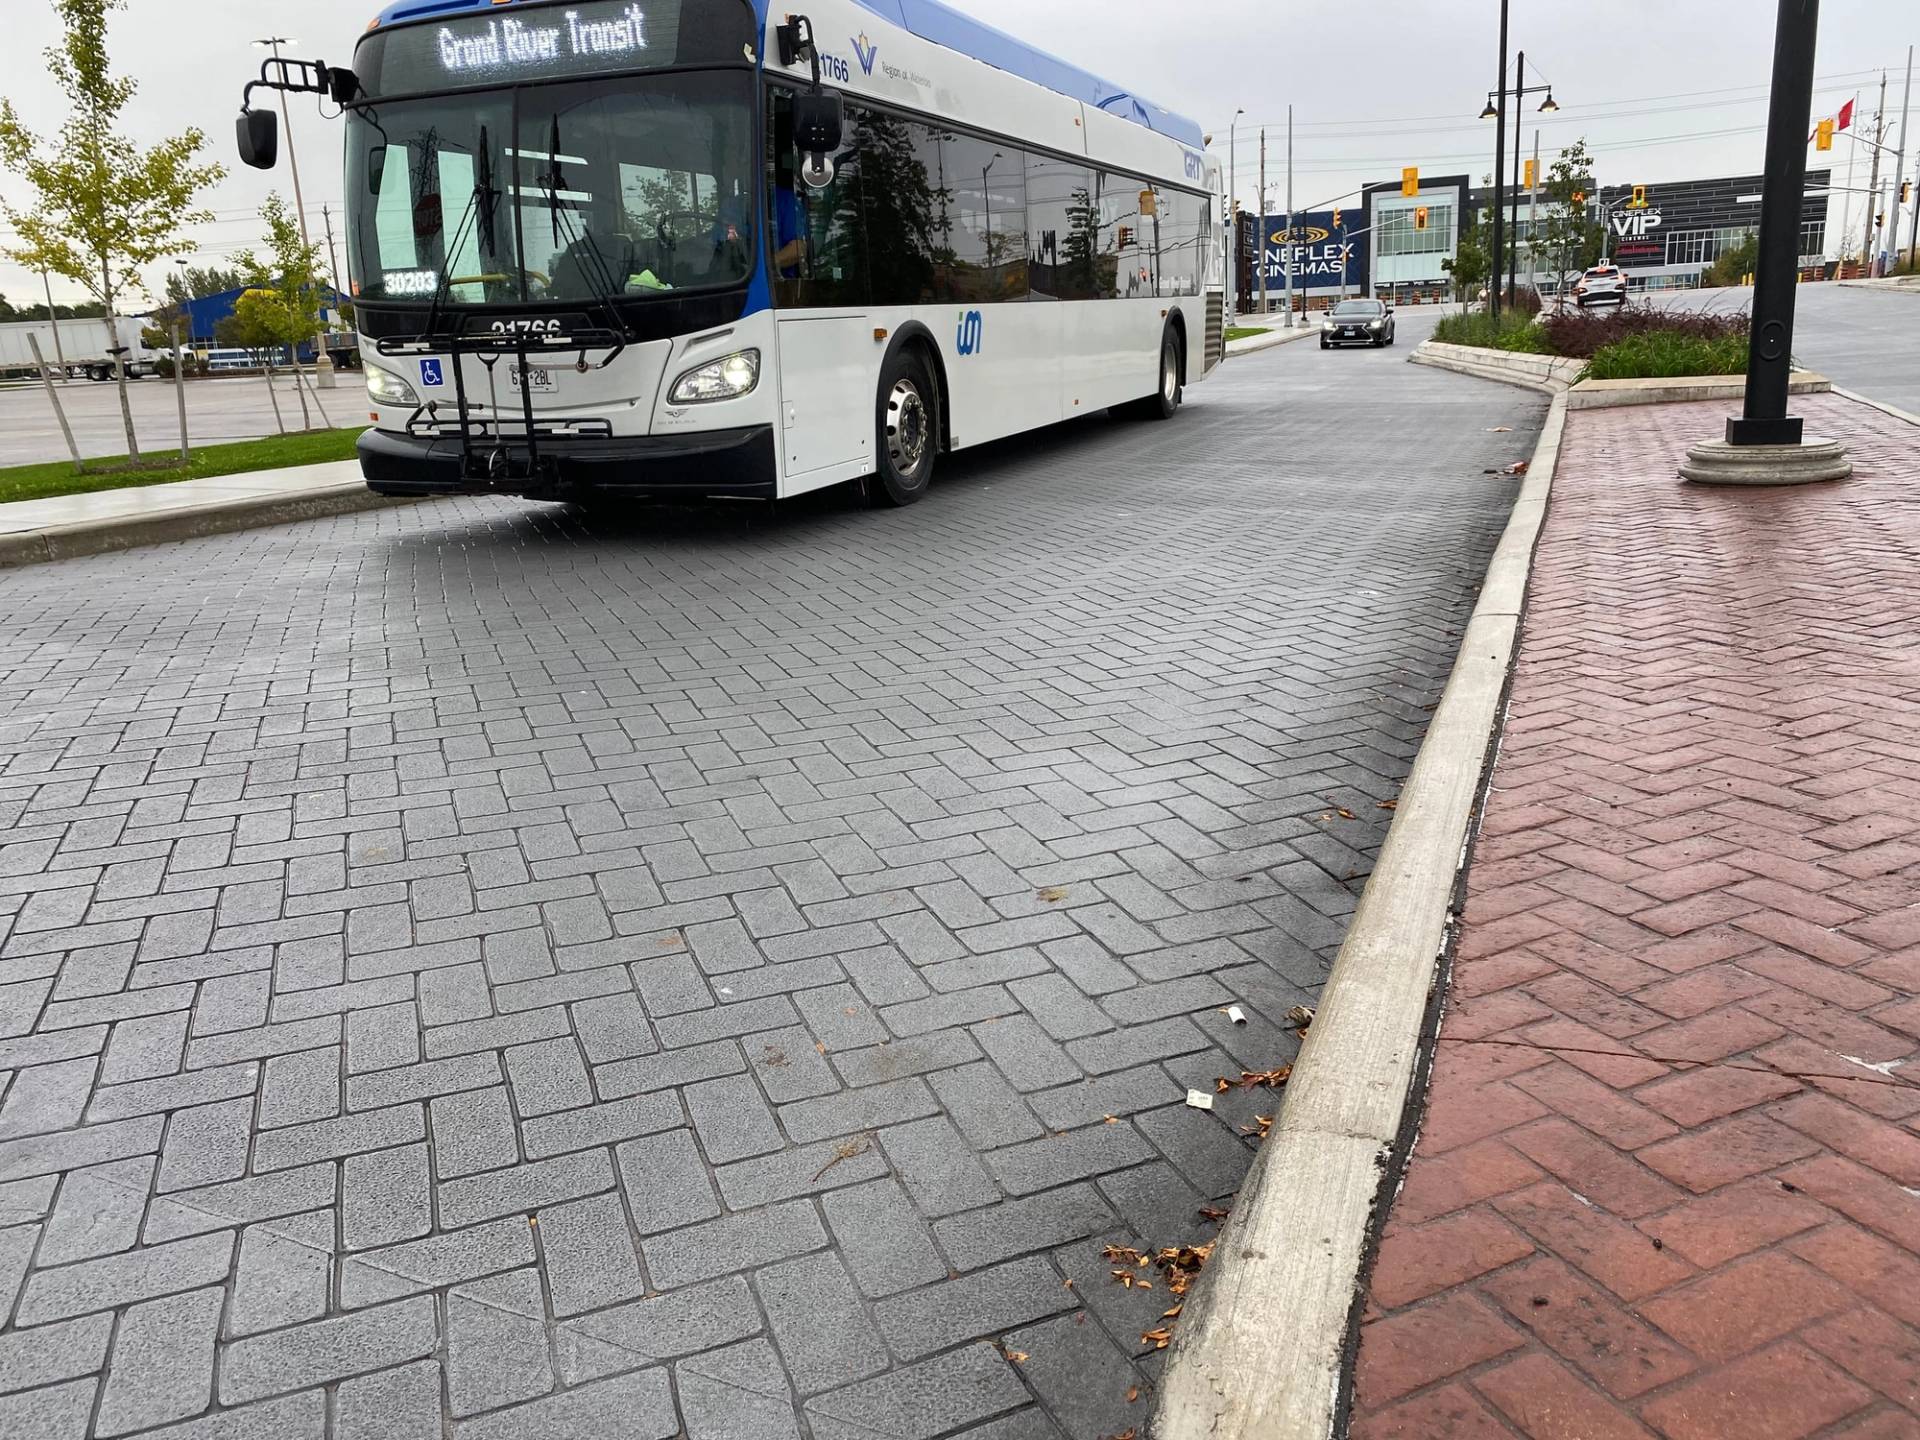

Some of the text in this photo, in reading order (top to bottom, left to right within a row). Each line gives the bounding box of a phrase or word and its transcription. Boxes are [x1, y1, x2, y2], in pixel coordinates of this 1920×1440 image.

[439, 3, 648, 68] Grand River Transit
[818, 52, 849, 83] 1766
[1184, 151, 1200, 180] GRT
[1612, 215, 1661, 236] VIP
[1256, 260, 1343, 278] CINEMAS
